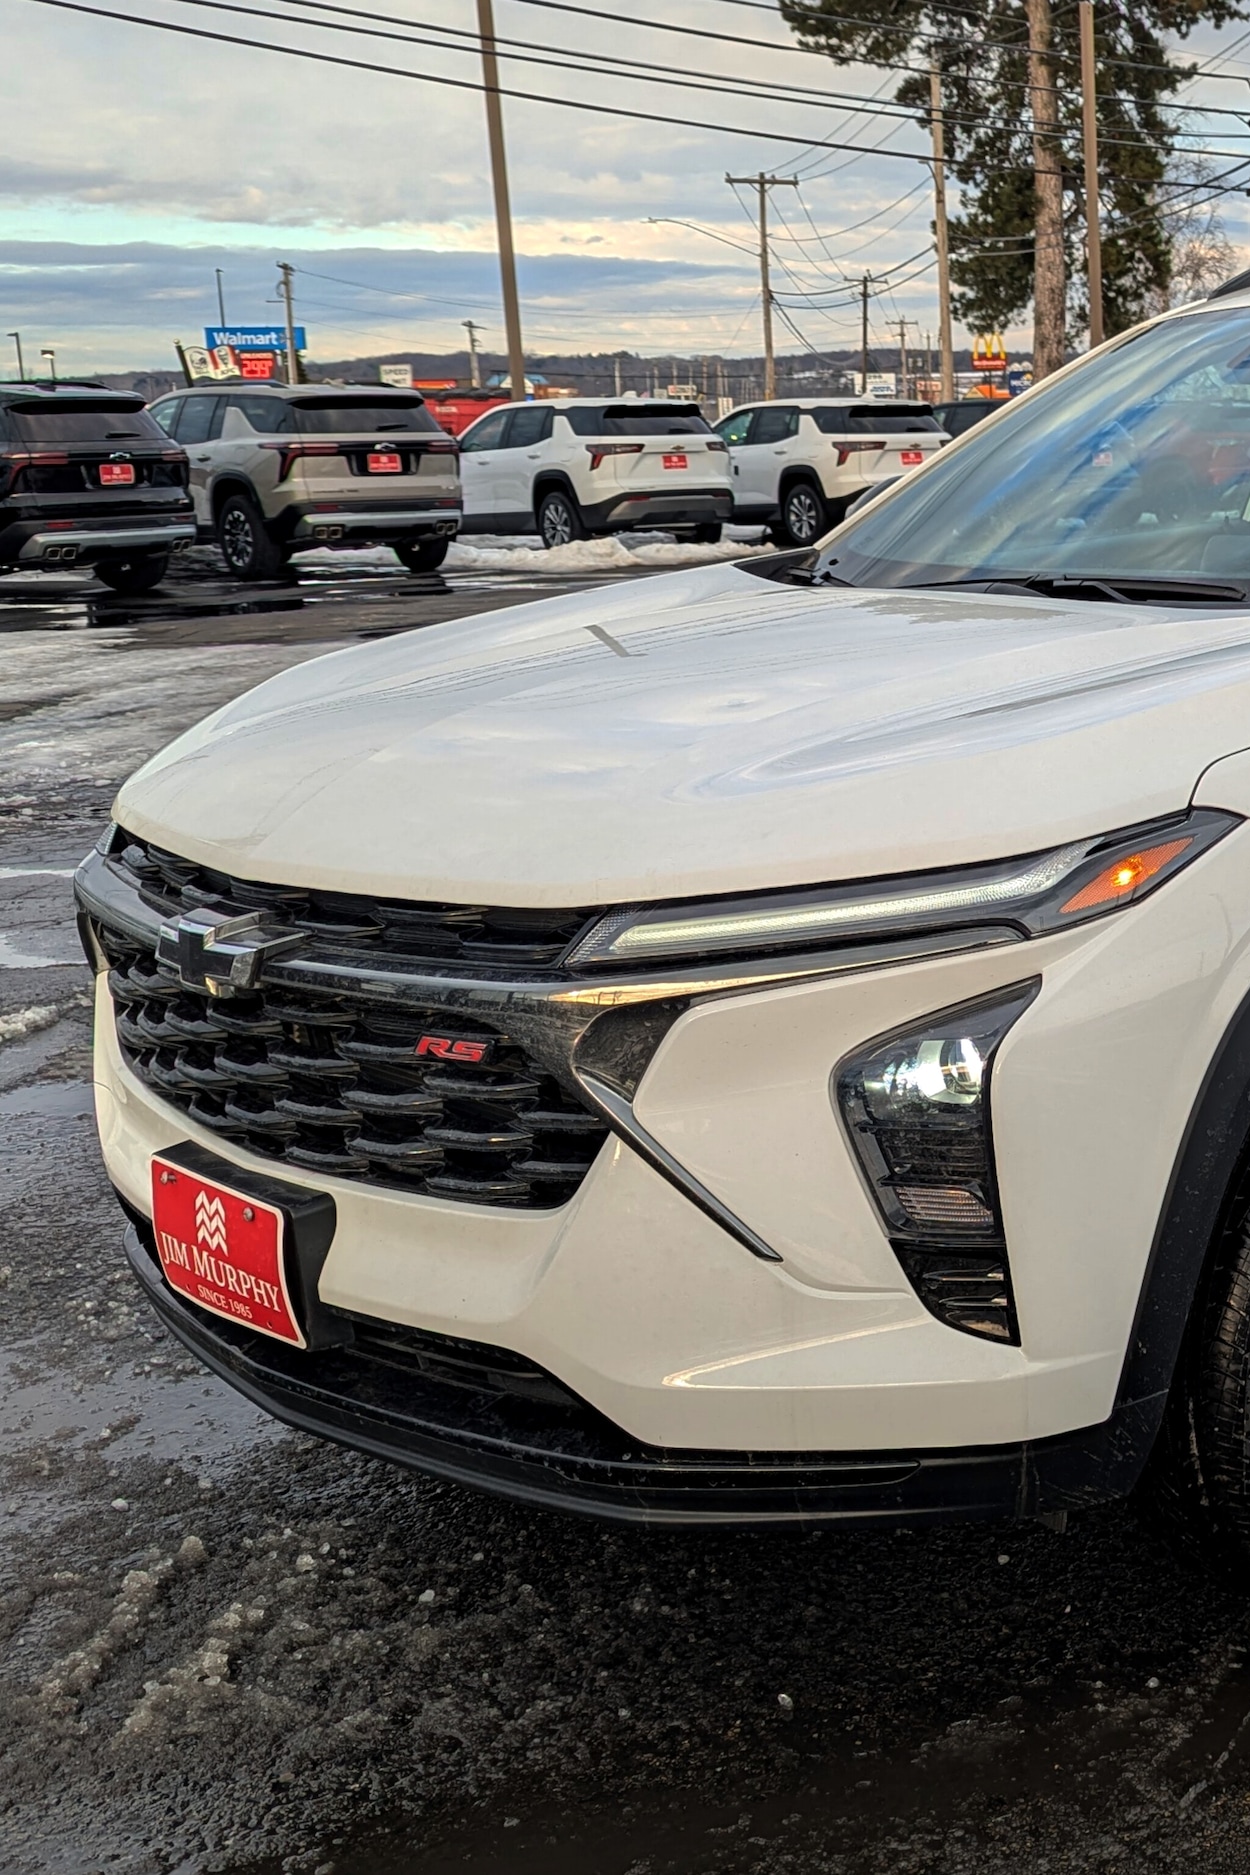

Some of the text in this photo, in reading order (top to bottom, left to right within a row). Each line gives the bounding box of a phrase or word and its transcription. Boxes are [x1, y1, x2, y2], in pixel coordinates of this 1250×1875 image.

[212, 331, 279, 345] Walmart
[415, 1035, 488, 1063] RS
[160, 1231, 281, 1313] JIM MURPHY
[197, 1284, 253, 1319] SINCE 1985
